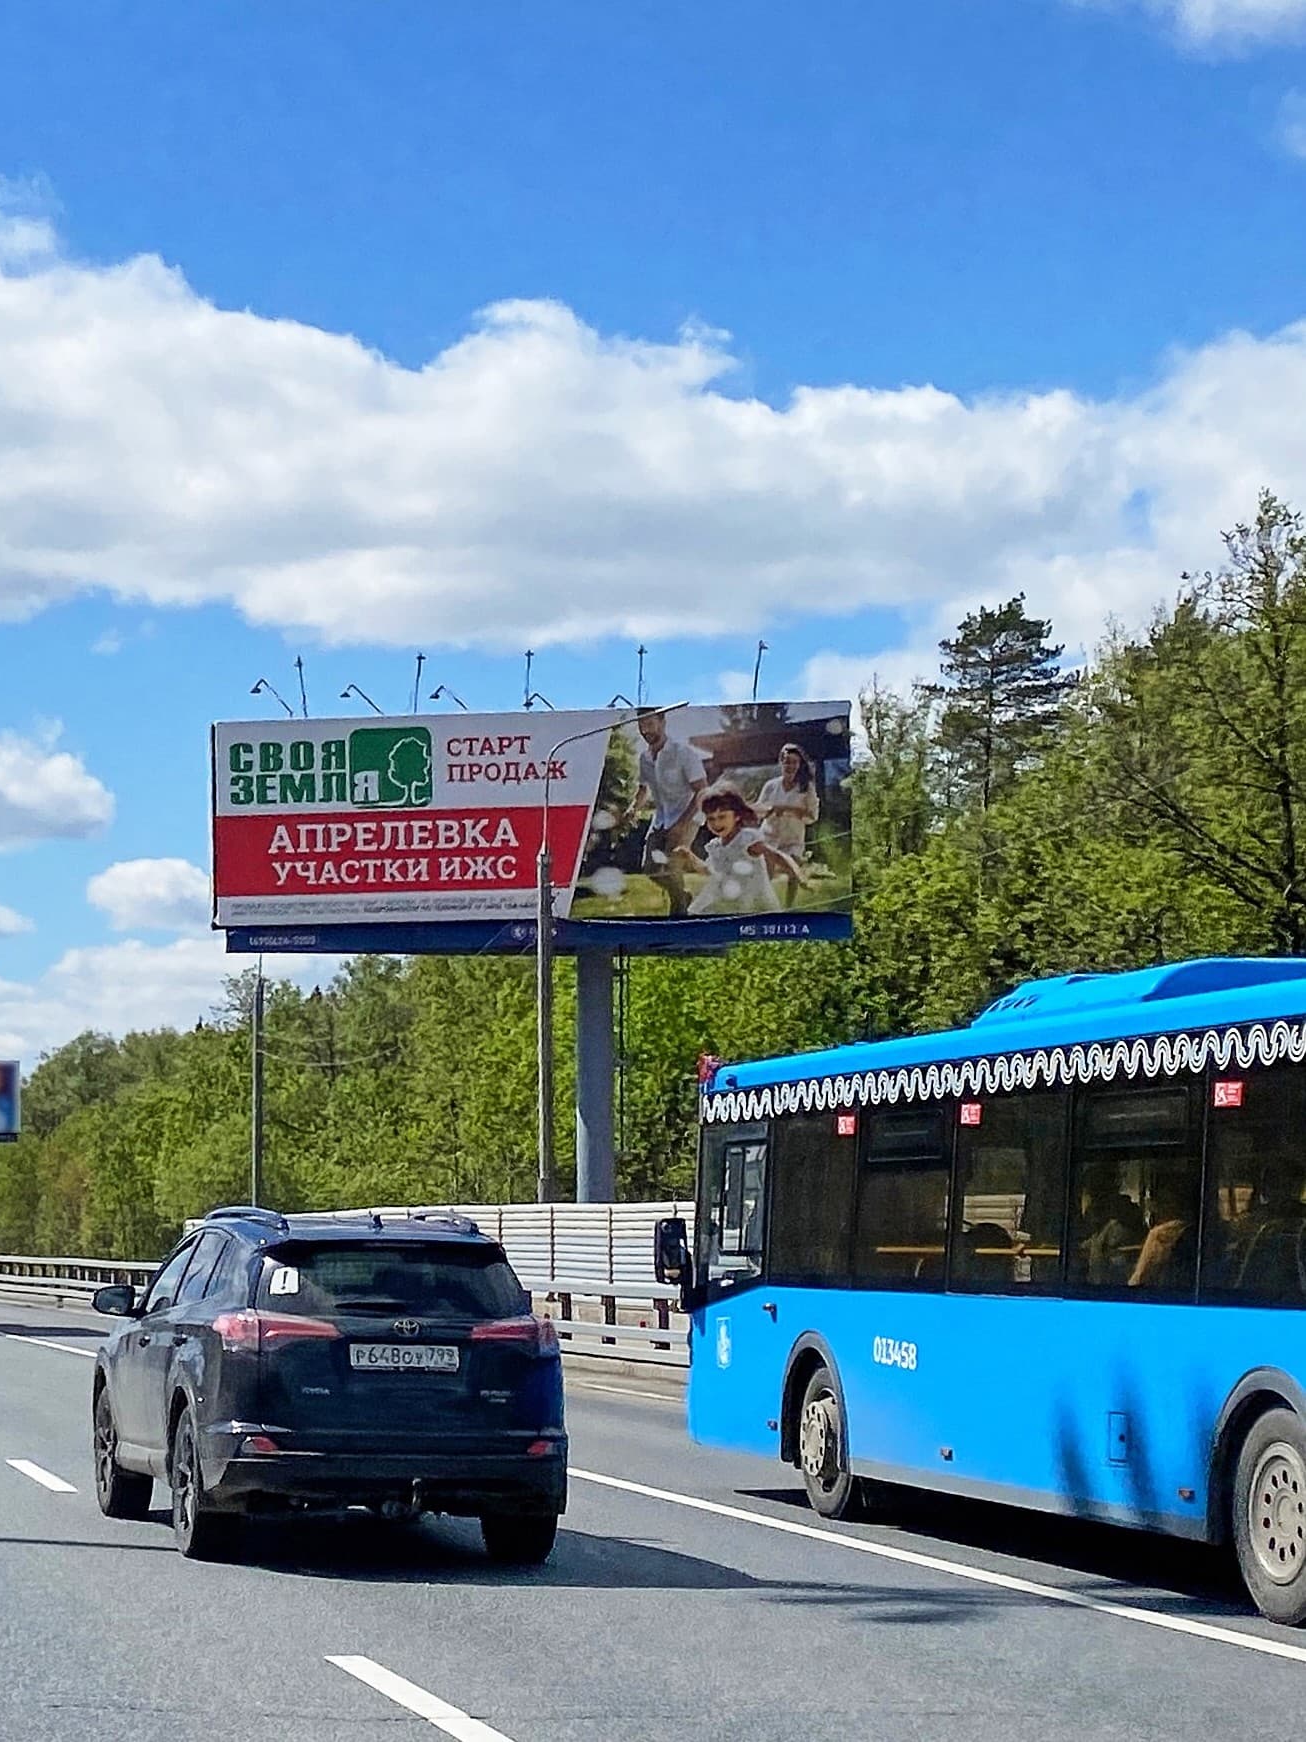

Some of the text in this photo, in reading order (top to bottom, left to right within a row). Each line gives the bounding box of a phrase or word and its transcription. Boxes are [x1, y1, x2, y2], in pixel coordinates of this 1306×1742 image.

[229, 739, 346, 773] СВОЯ
[446, 735, 531, 757] СТАРТ
[229, 769, 380, 805] ЗЕМЛЯ
[446, 760, 568, 784] ПРОДАЖ
[267, 817, 519, 855] АПРЕЛЕВКА
[271, 855, 518, 886] УЧАСТКИ ИЖС
[873, 1335, 917, 1371] 013458
